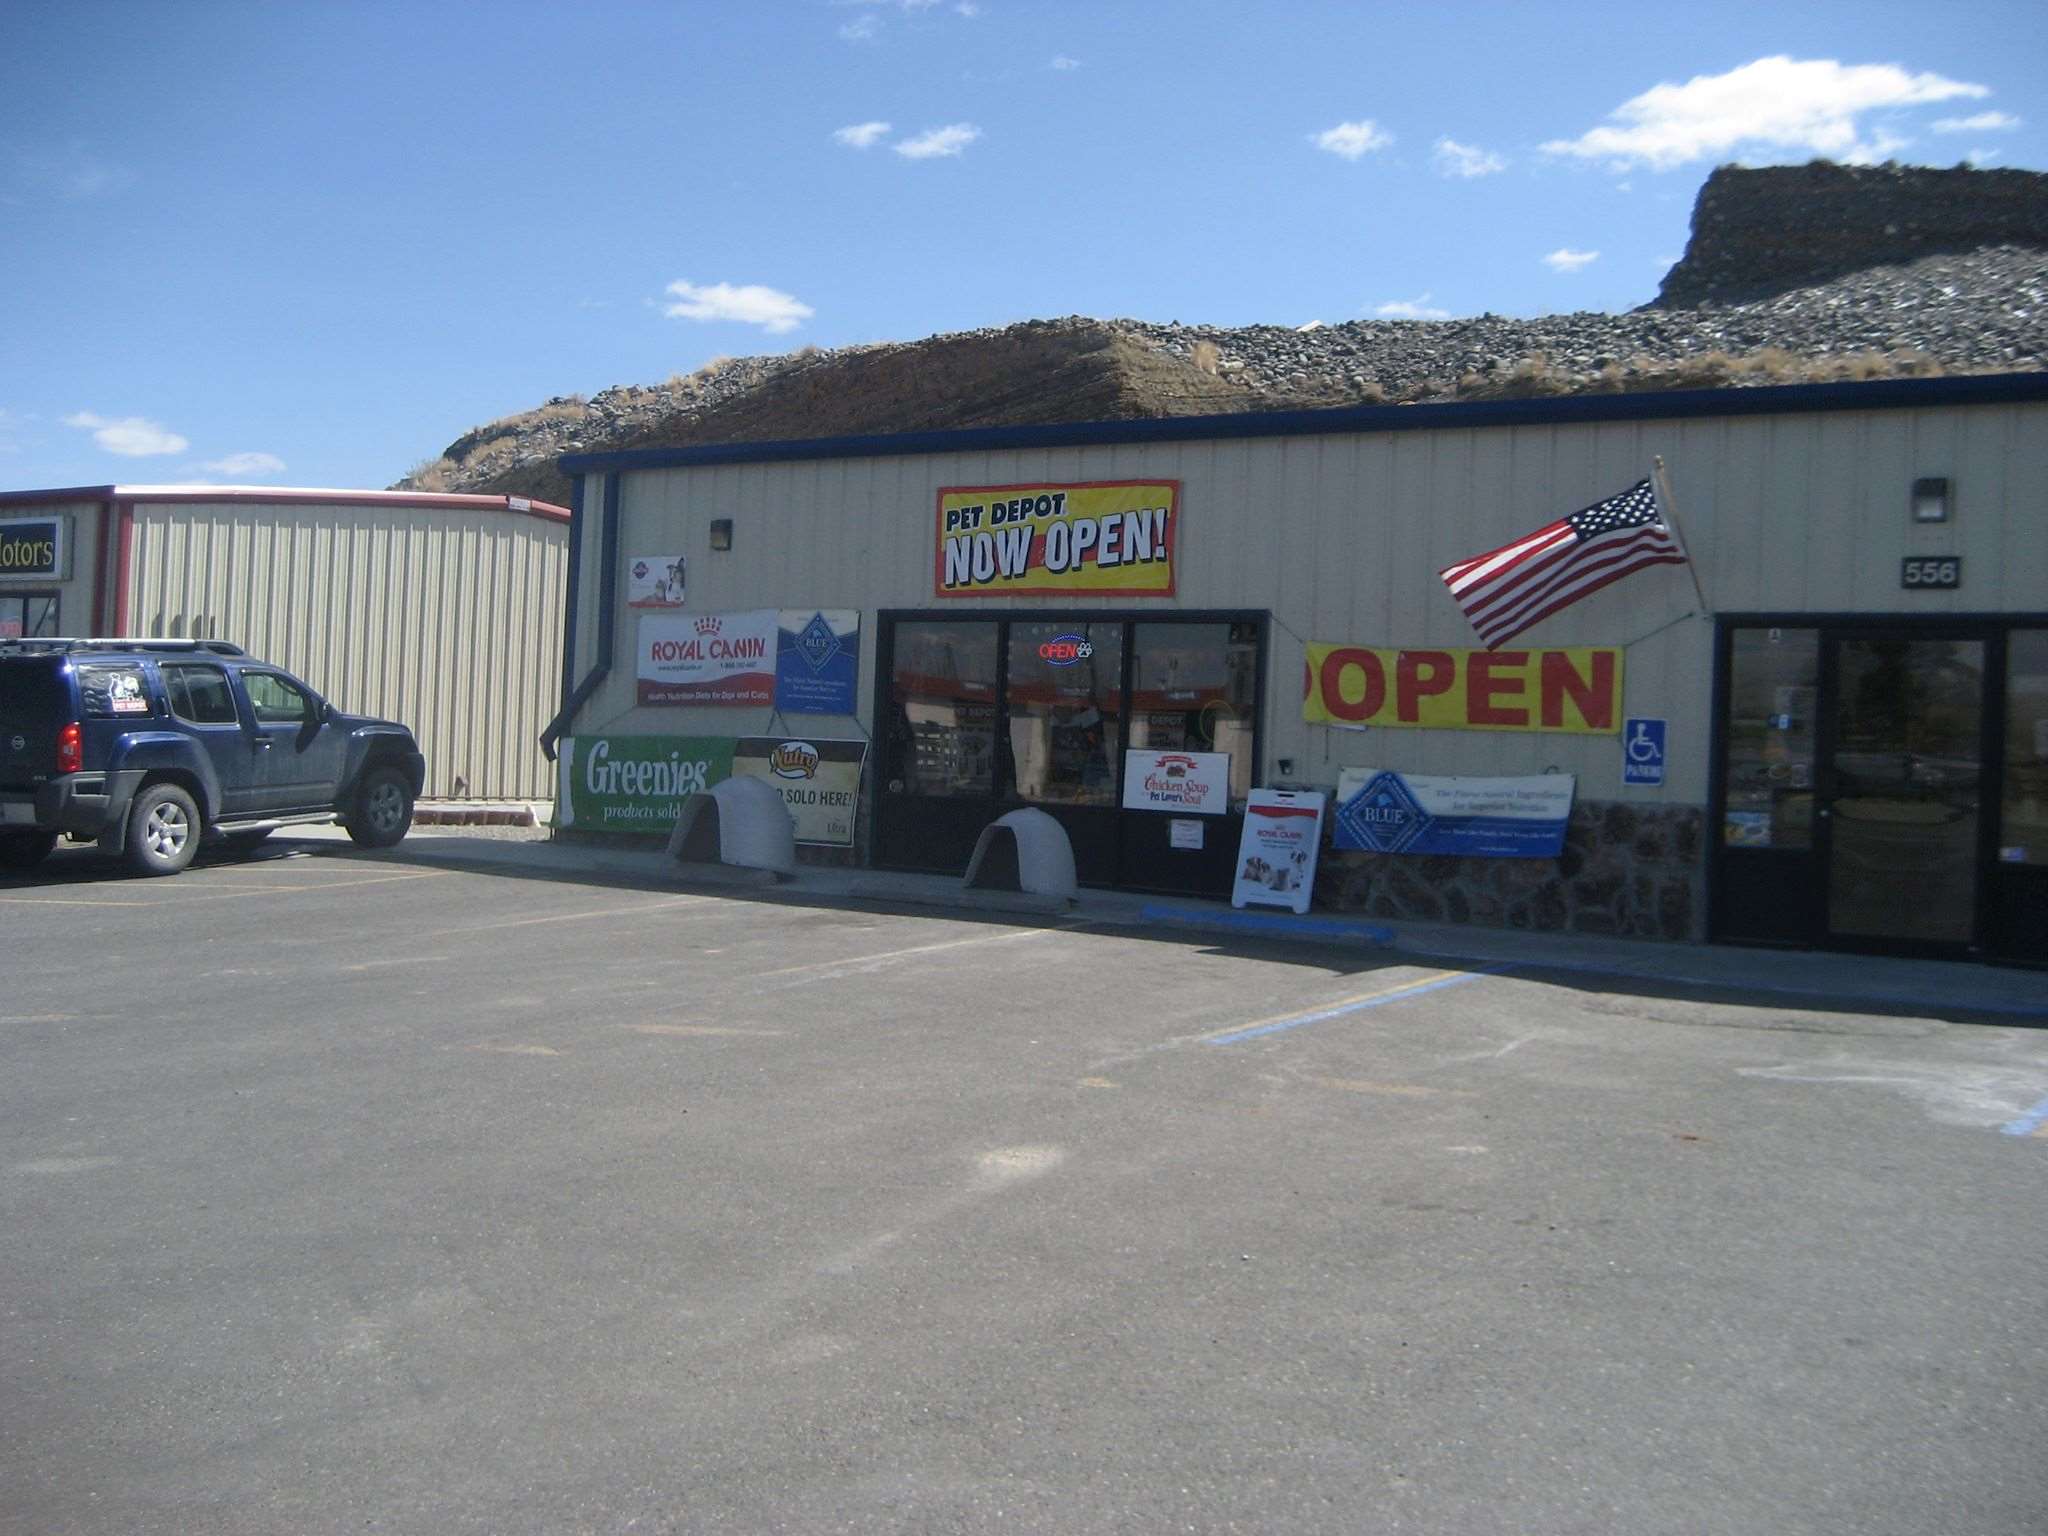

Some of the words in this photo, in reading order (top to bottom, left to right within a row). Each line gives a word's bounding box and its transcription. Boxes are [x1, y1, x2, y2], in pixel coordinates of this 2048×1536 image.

[945, 505, 984, 531] PET
[990, 493, 1066, 526] DEPOT
[0, 535, 54, 568] otors
[944, 524, 1034, 587] NOW
[1043, 508, 1168, 574] OPEN!
[1905, 562, 1956, 584] 556
[651, 640, 705, 661] ROYAL
[709, 638, 766, 659] CANIN
[805, 638, 827, 648] BLUE
[1039, 643, 1078, 659] OPEN
[1320, 647, 1615, 729] OPEN
[586, 740, 707, 796] Greenies
[771, 744, 819, 777] Nutro
[1144, 773, 1183, 791] Chicken
[1185, 778, 1209, 796] Soup
[786, 788, 816, 805] SOLD
[819, 790, 854, 807] HERE!
[1183, 793, 1201, 805] Soul
[603, 802, 654, 822] products
[657, 802, 681, 819] sold
[1365, 807, 1405, 824] BLUE
